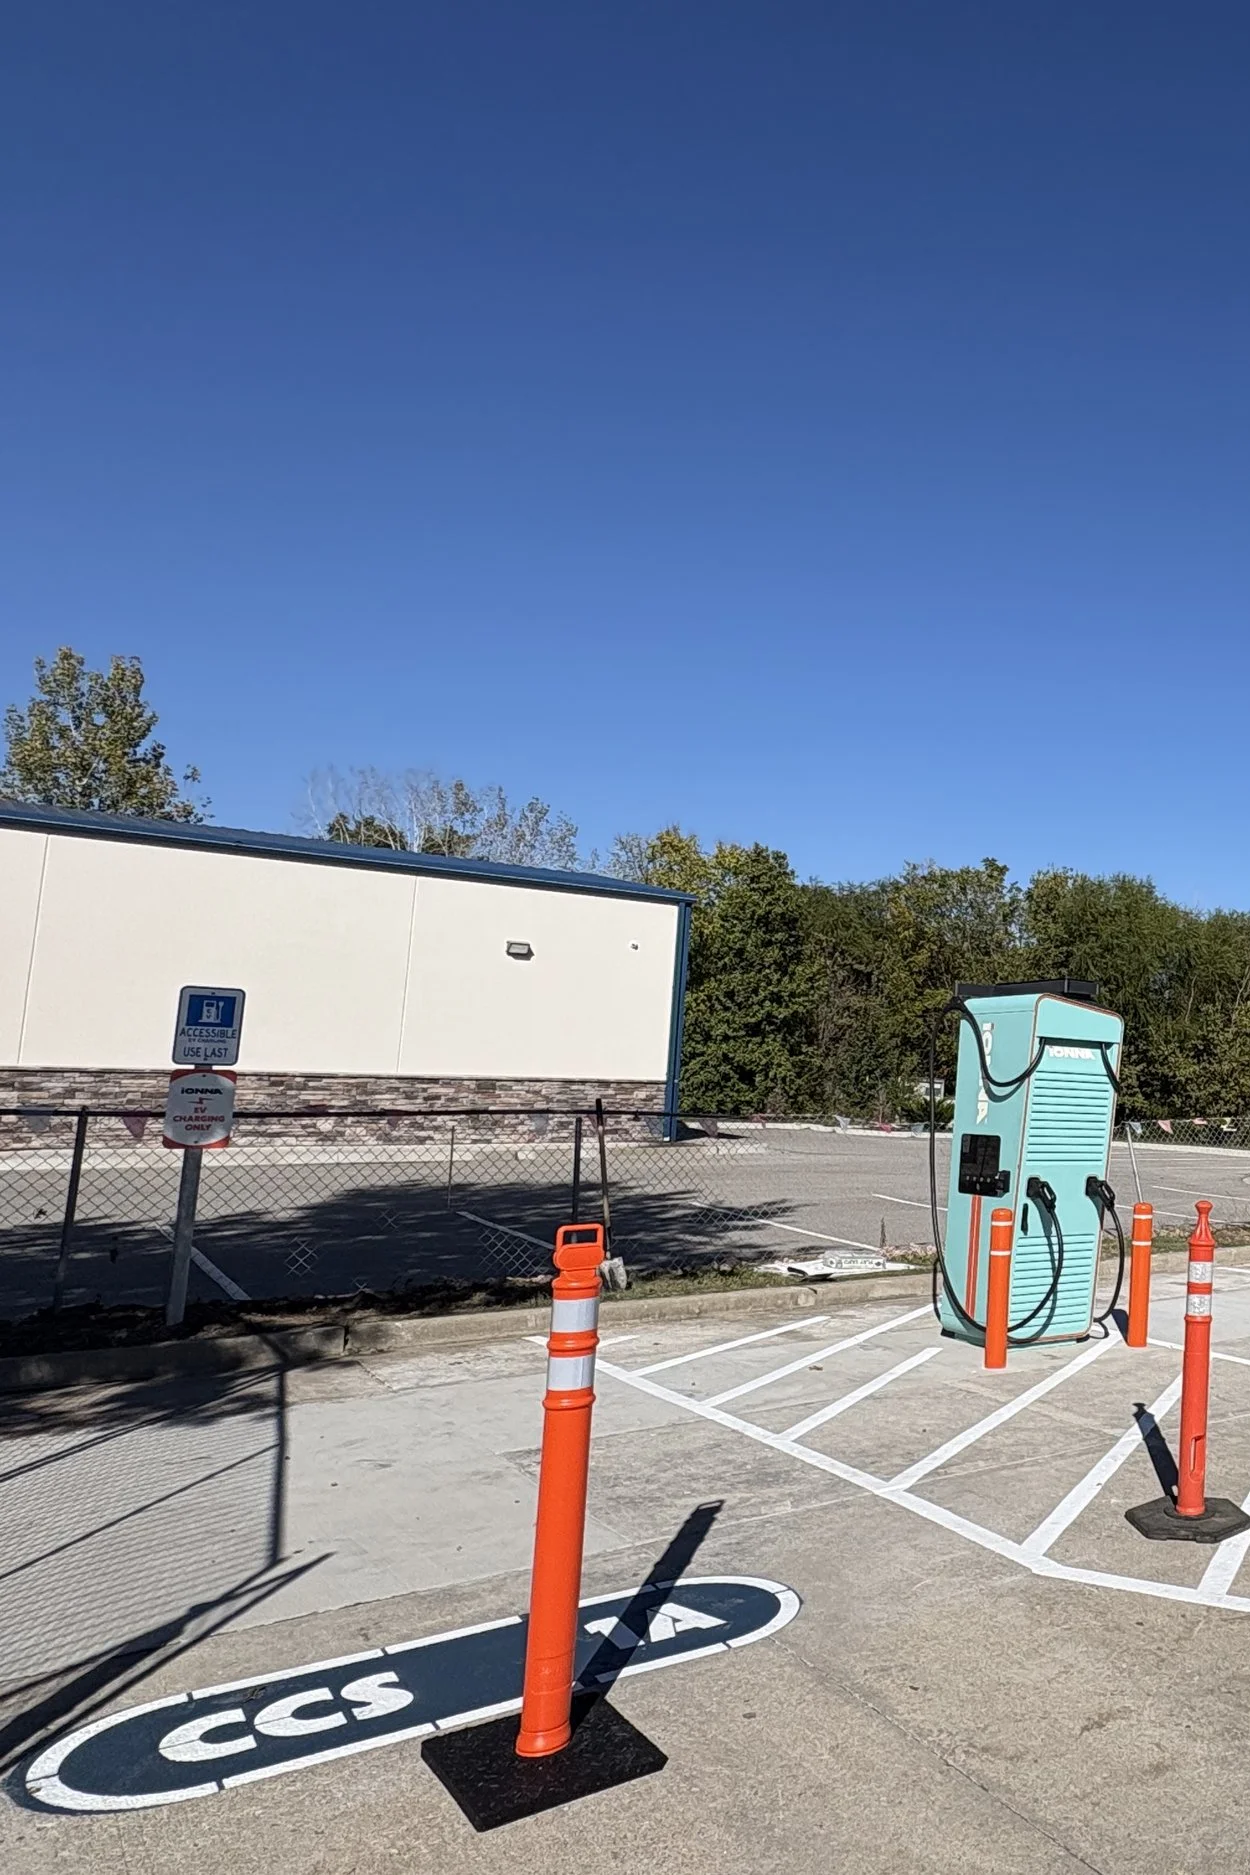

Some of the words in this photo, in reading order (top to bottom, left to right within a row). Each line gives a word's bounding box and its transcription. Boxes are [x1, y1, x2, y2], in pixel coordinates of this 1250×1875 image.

[180, 1027, 237, 1039] ACCESSIBLE
[183, 1046, 202, 1057] USE
[204, 1047, 229, 1058] LAST
[158, 1671, 414, 1762] CCS
[583, 1602, 729, 1650] 1A
